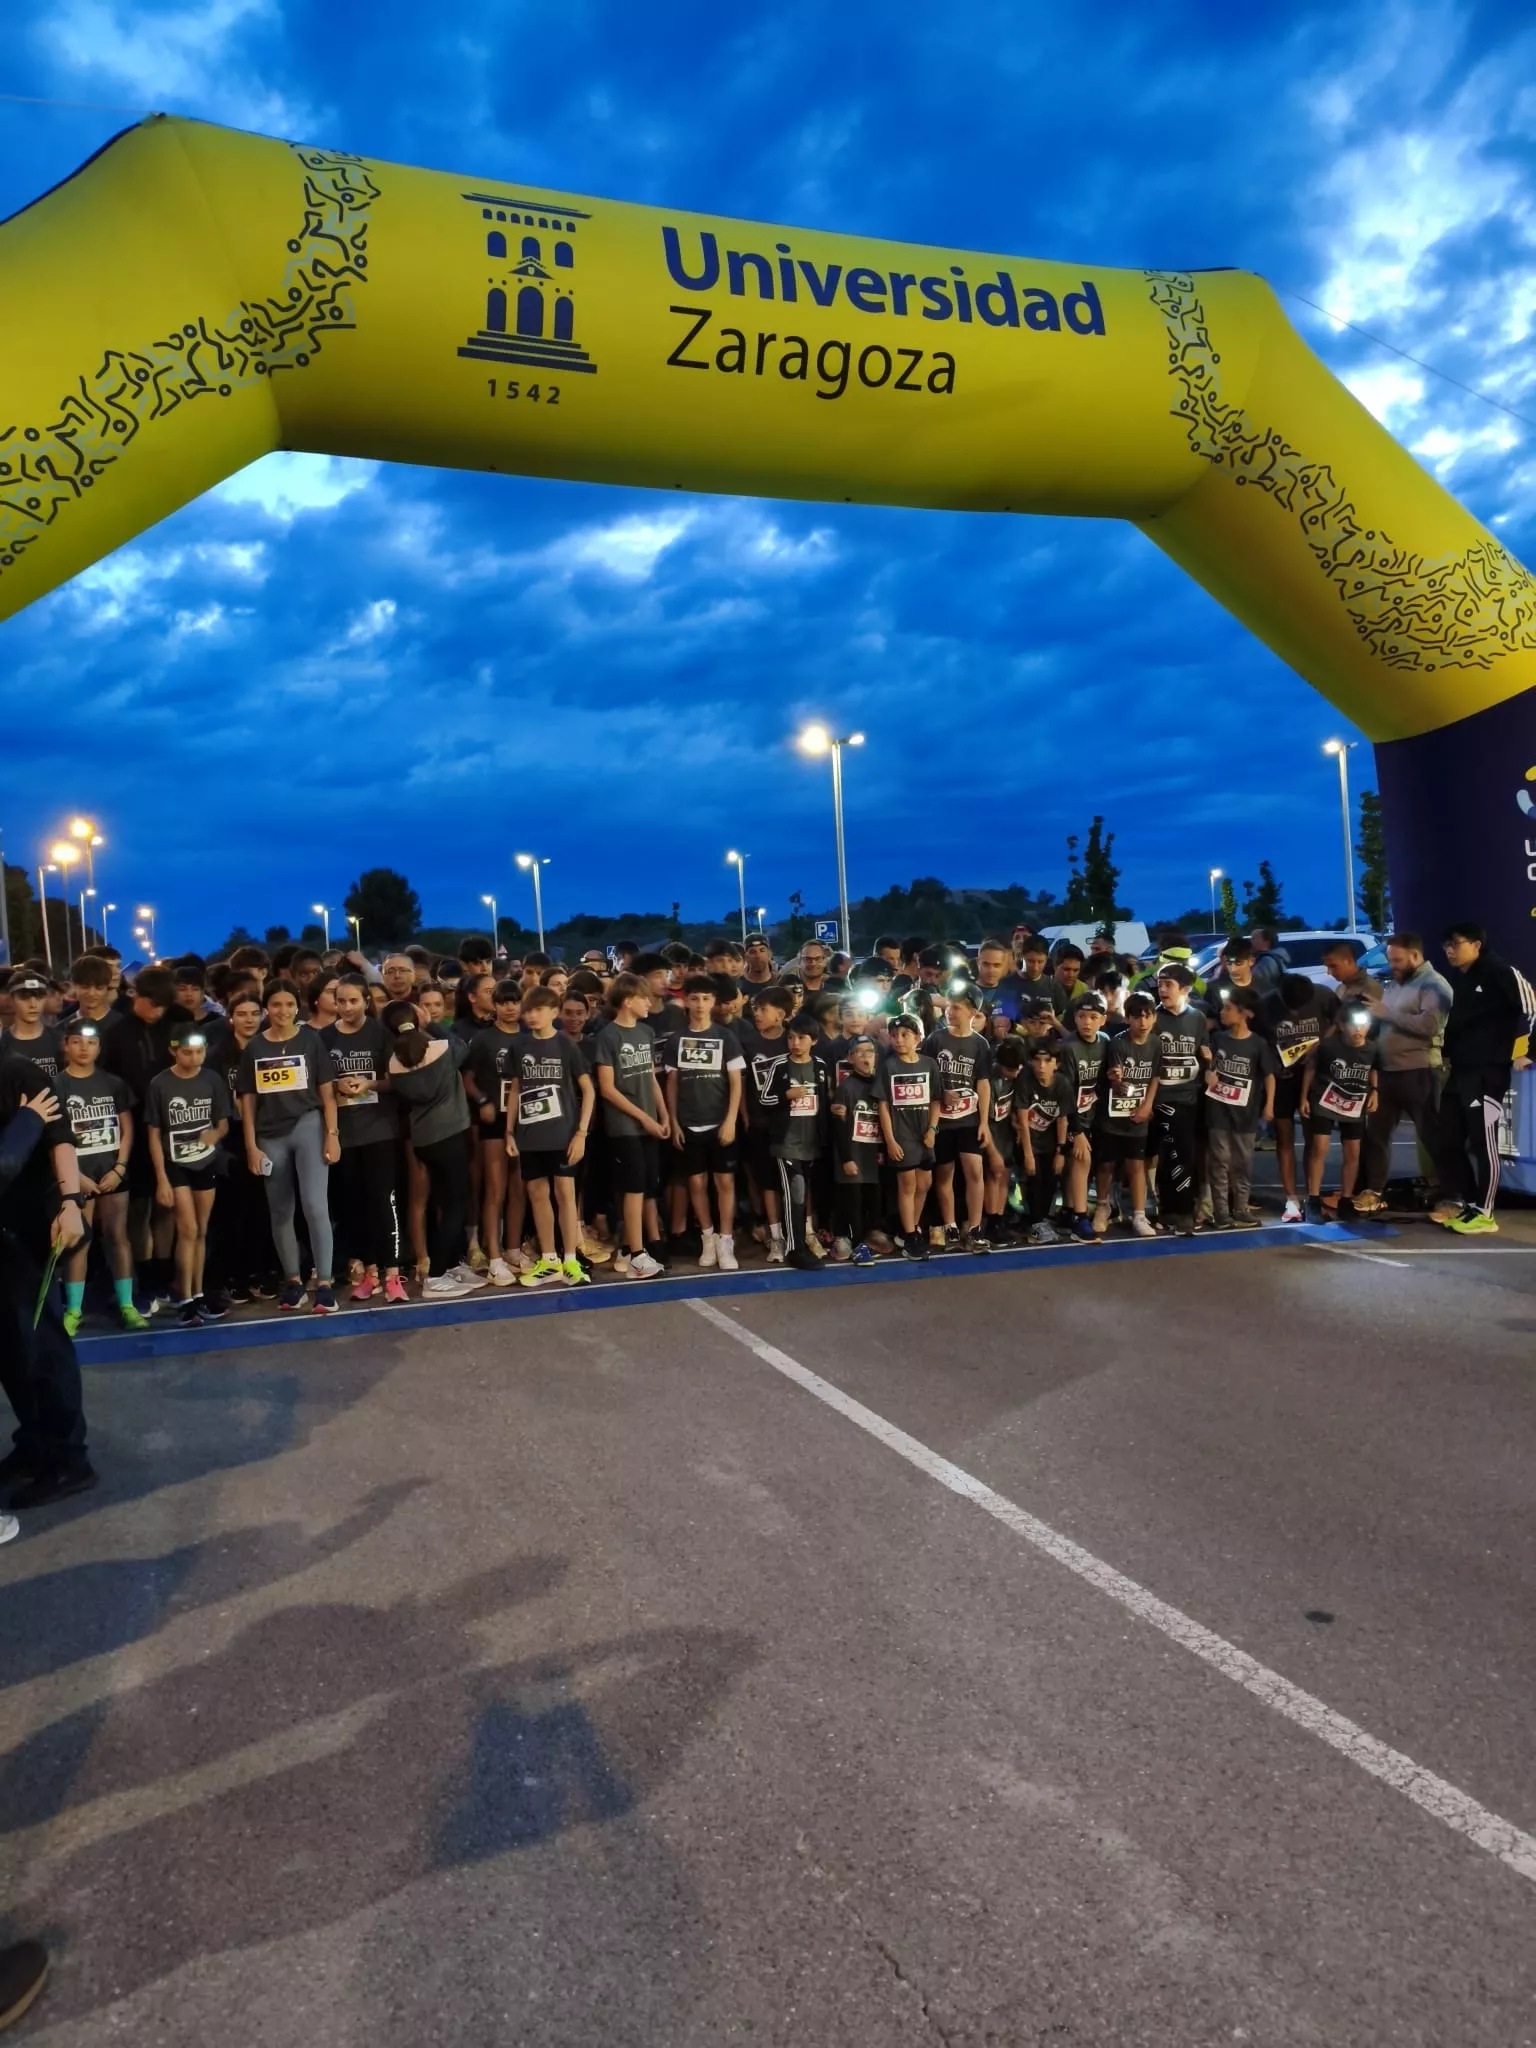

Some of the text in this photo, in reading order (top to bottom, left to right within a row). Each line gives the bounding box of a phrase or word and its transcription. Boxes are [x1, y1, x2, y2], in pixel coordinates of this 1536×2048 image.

[661, 226, 1107, 337] Universidad
[667, 305, 957, 400] Zaragoza
[486, 379, 562, 405] 1542
[817, 923, 828, 936] P
[685, 1049, 709, 1061] 144
[262, 1070, 290, 1083] 505
[1166, 1067, 1185, 1078] 181
[897, 1085, 922, 1097] 308
[1215, 1083, 1235, 1097] 301
[523, 1101, 544, 1115] 150
[1115, 1099, 1137, 1109] 202
[168, 1107, 212, 1126] Nocturn
[859, 1123, 879, 1134] 304
[80, 1130, 111, 1146] 254
